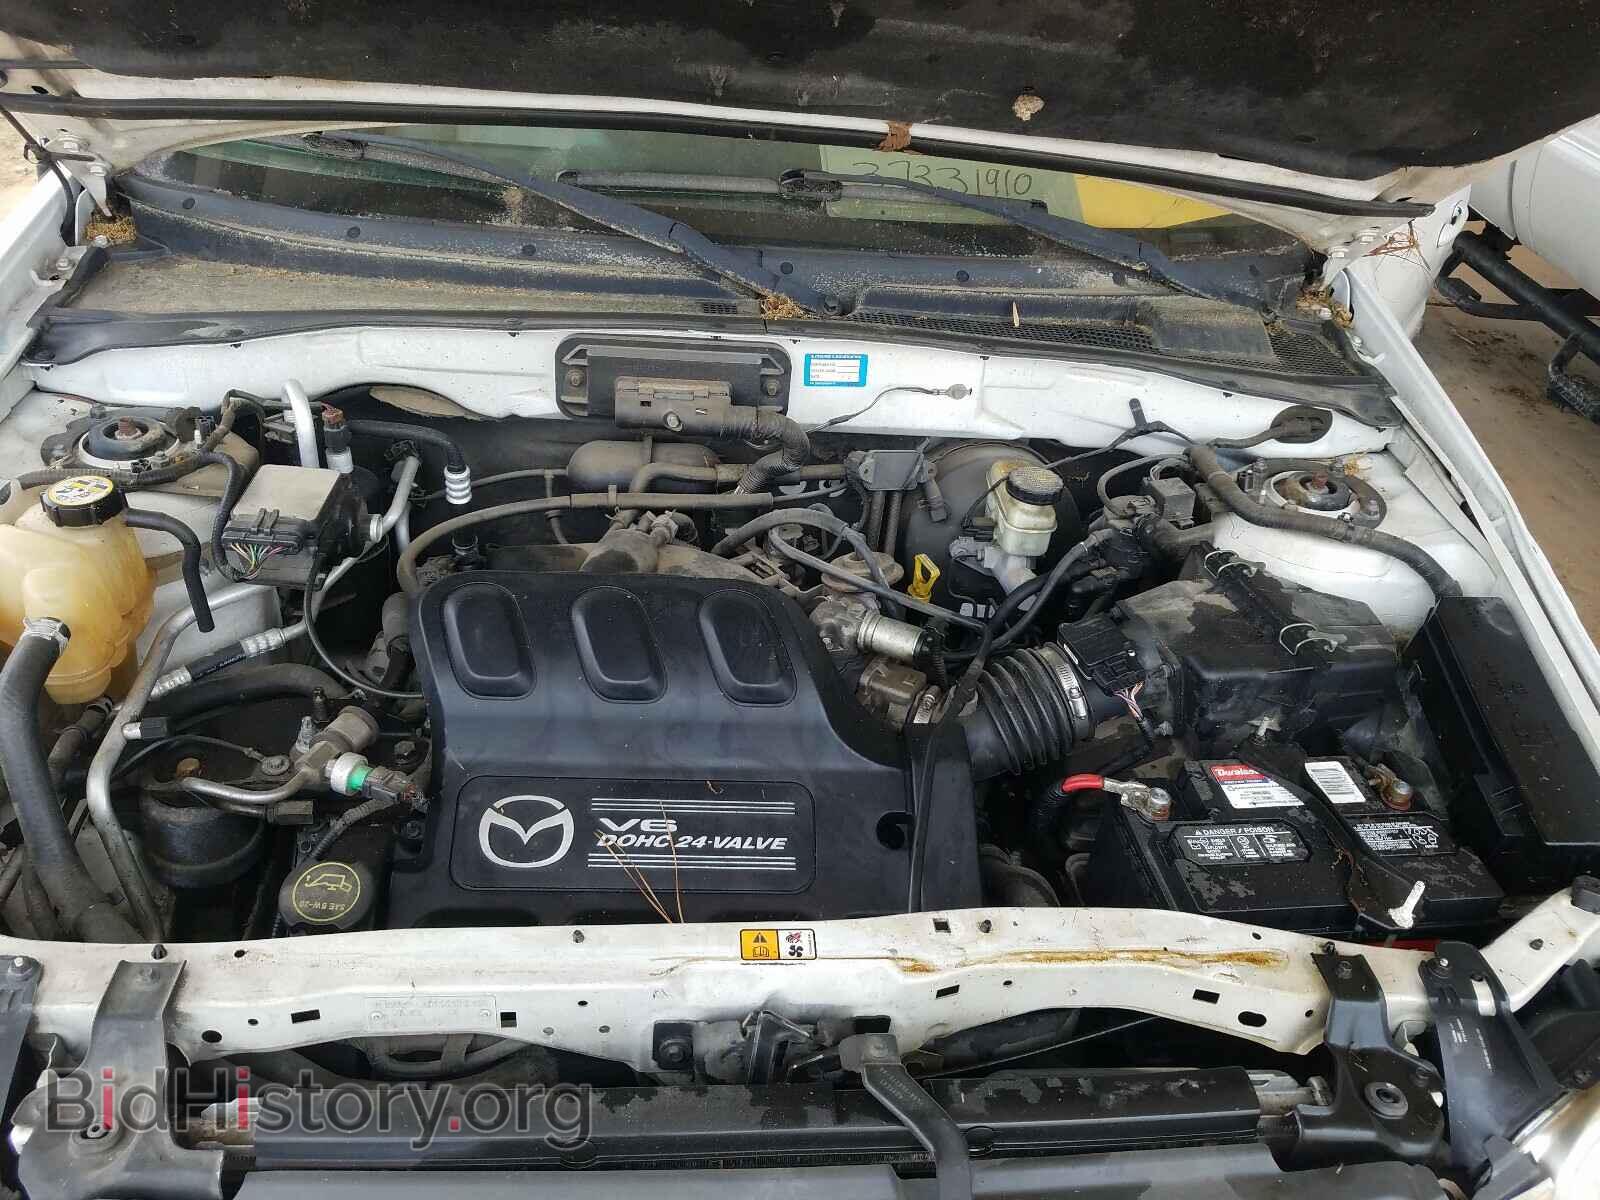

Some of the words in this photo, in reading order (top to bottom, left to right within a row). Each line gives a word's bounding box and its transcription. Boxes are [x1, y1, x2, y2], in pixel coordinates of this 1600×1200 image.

[599, 818, 678, 832] V6
[1244, 826, 1274, 834] POISON
[596, 834, 671, 848] DOHC
[674, 835, 788, 850] 24-VALVE
